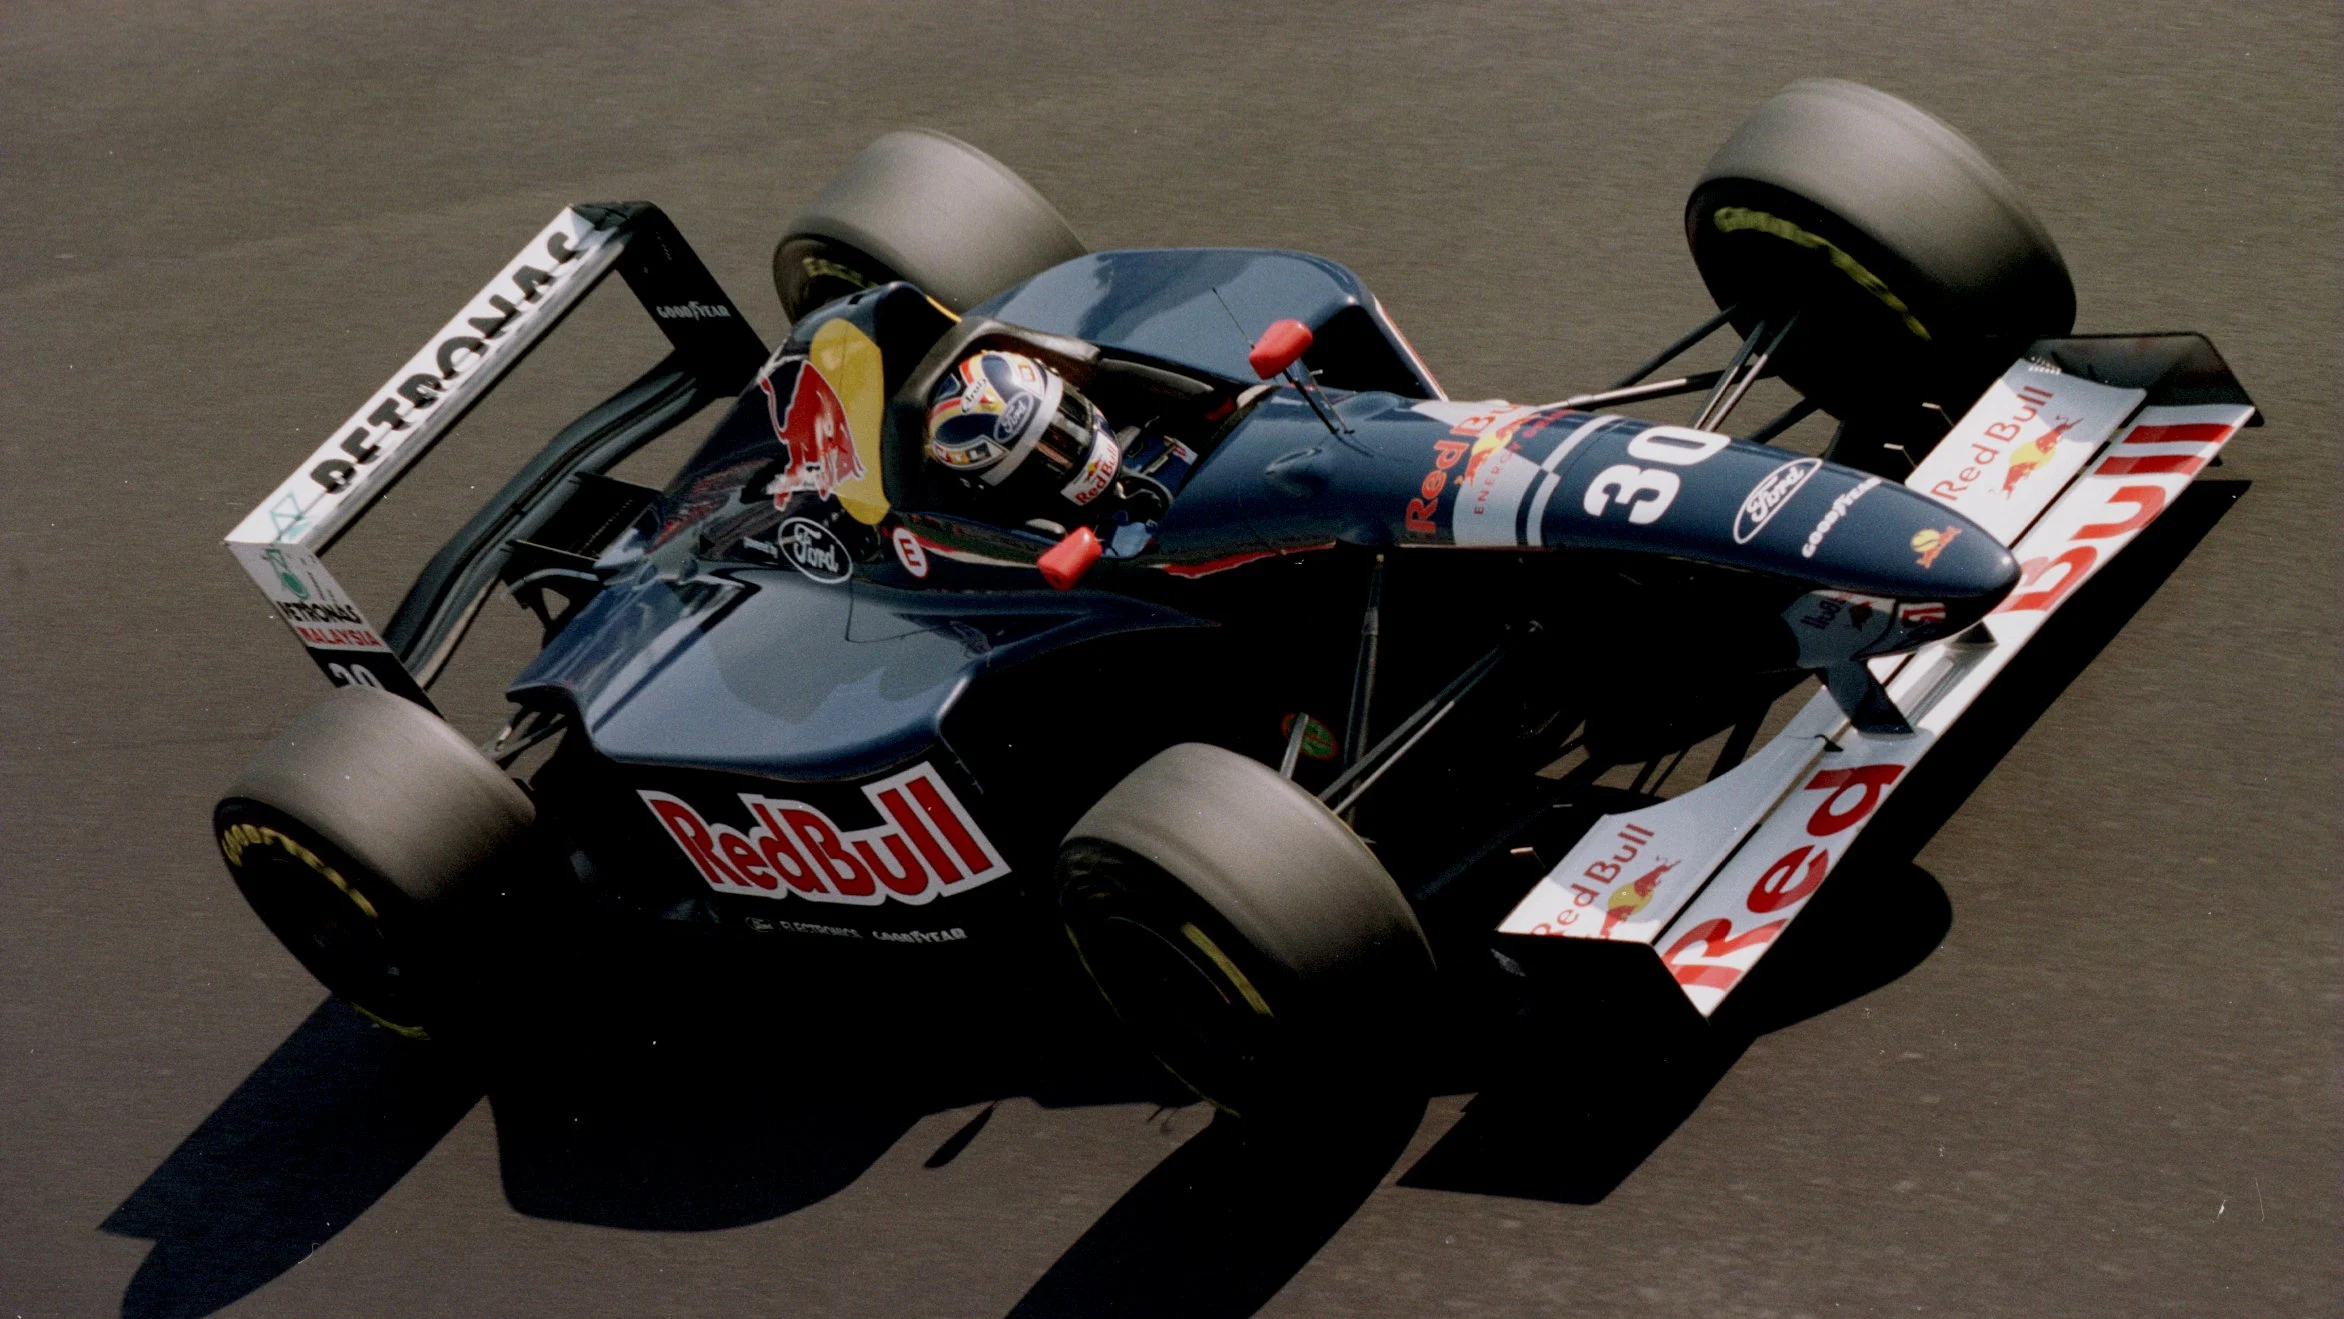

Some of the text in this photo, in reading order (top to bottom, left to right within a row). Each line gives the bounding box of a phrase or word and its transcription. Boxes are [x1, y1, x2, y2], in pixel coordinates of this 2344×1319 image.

[656, 300, 731, 321] GOODYEAR
[1001, 398, 1031, 434] Ford
[1930, 384, 2056, 502] Red Bull
[1074, 481, 1109, 504] Red
[1405, 440, 1470, 533] Red
[1584, 426, 1731, 525] 30
[1743, 465, 1806, 517] Ford
[1802, 477, 1882, 558] GOODYEAR
[1989, 422, 2234, 615] Bull
[793, 522, 840, 574] Ford
[898, 537, 922, 567] E
[297, 626, 383, 646] MALAYSIA
[1586, 822, 1655, 884] Bull
[872, 928, 969, 943] GOODYEAR
